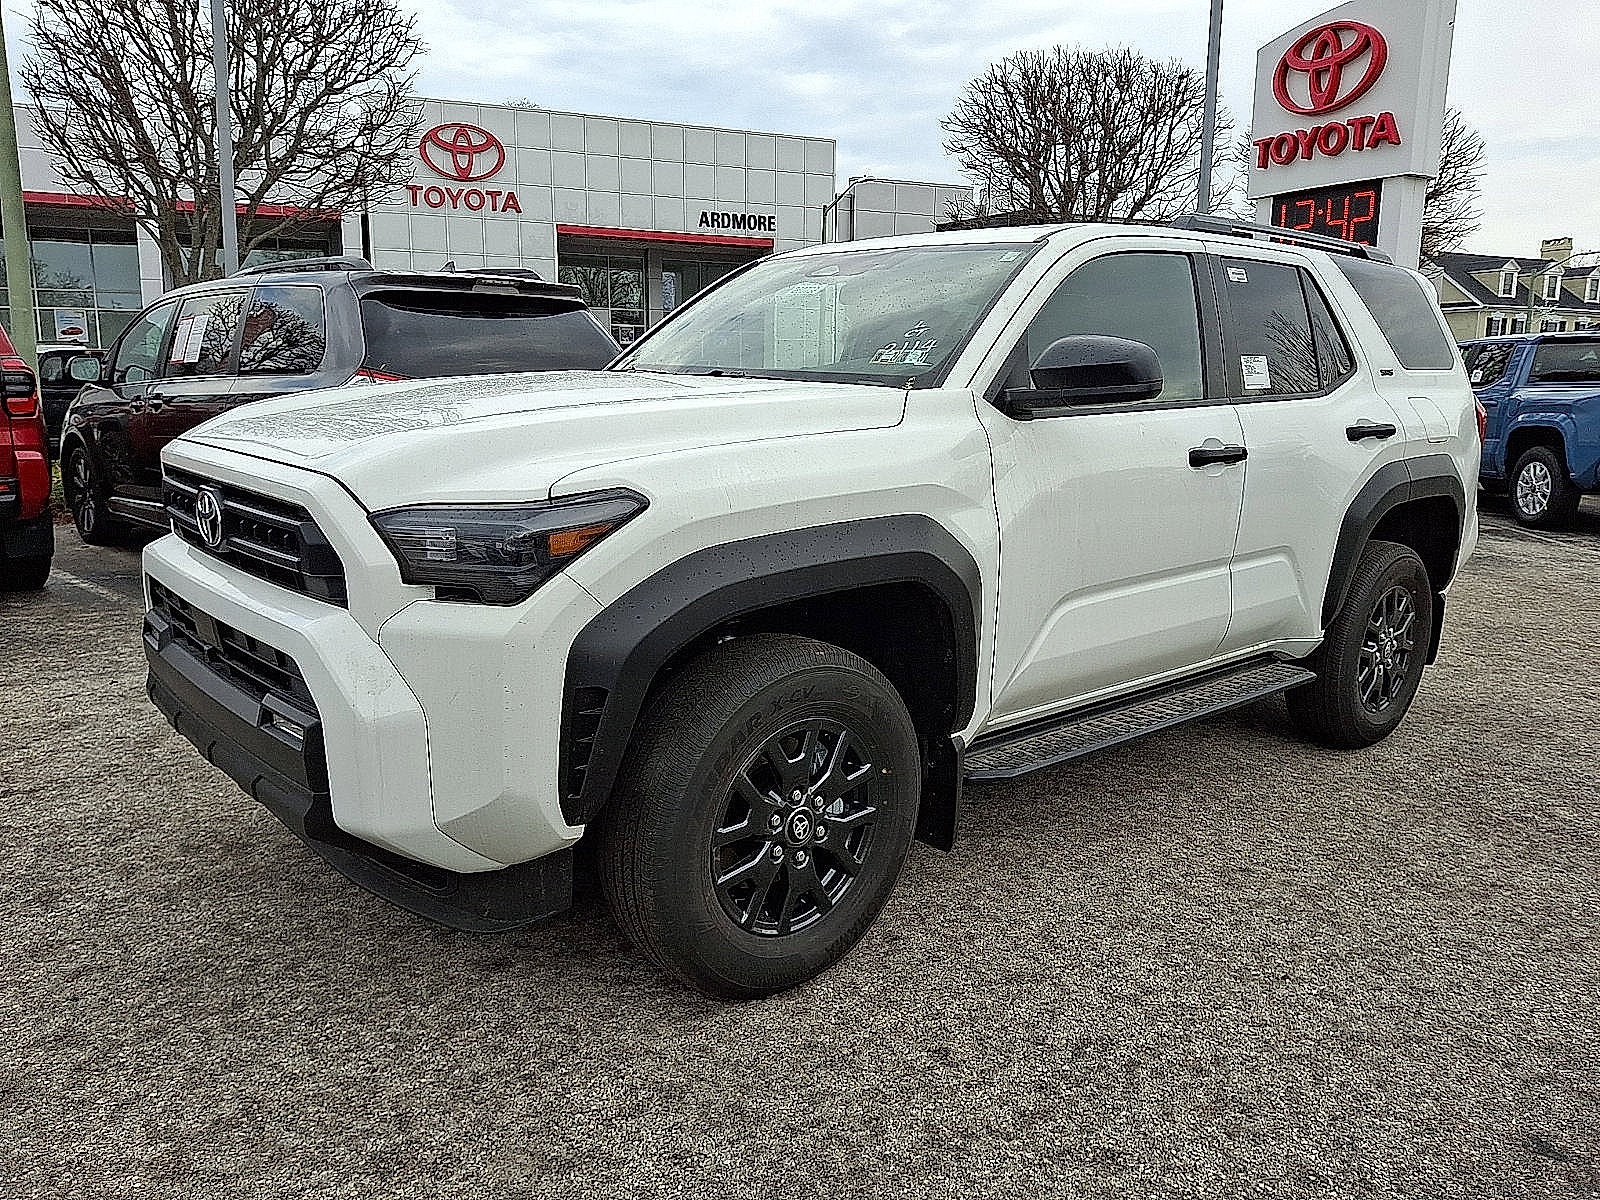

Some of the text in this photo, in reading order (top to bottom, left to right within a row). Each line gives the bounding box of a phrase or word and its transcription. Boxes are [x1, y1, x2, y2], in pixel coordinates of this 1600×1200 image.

[1253, 112, 1401, 169] TOYOTA
[406, 184, 522, 214] TOYOTA
[698, 211, 777, 233] ARDMORE
